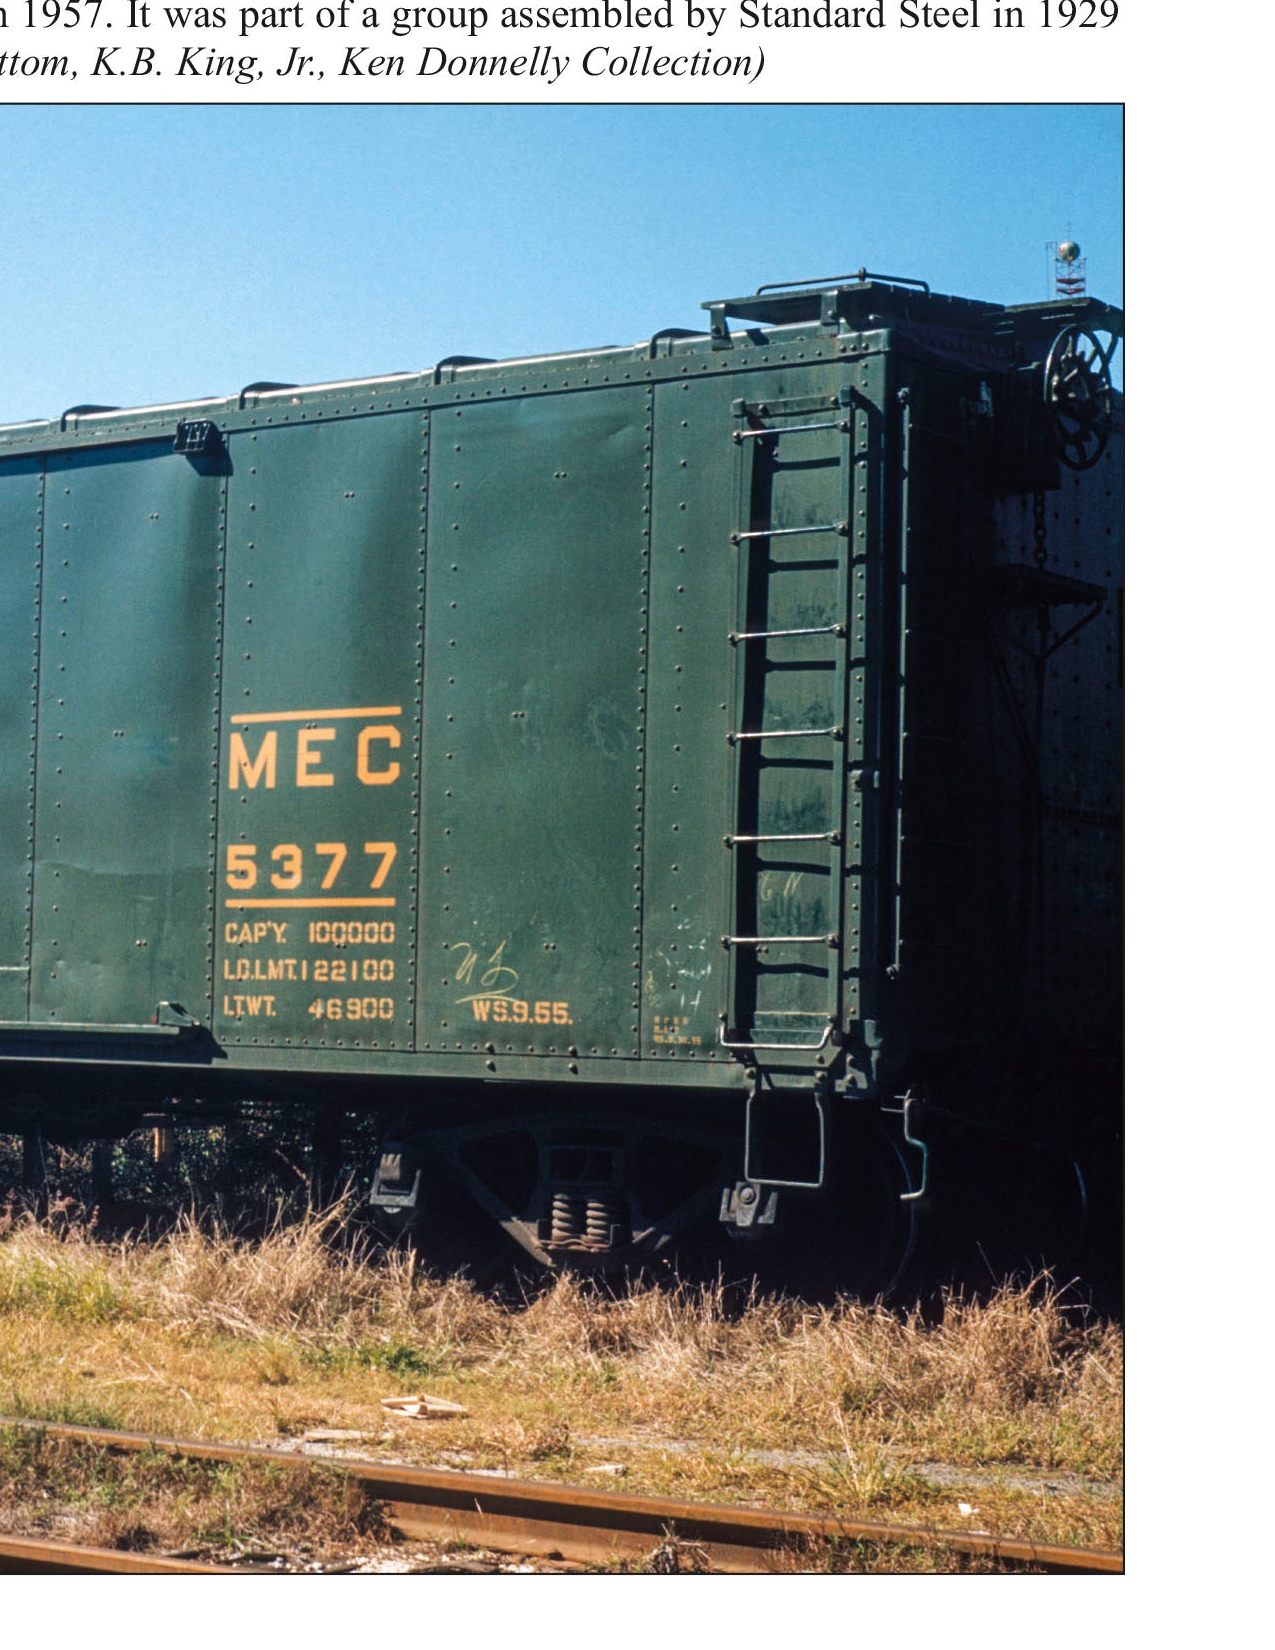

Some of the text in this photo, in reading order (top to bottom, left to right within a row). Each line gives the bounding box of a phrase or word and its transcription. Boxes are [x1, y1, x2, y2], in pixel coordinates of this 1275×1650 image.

[228, 724, 402, 790] MEC
[225, 841, 397, 890] 5377
[309, 921, 395, 944] 100000
[301, 958, 395, 983] 122100
[308, 997, 394, 1021] 46900
